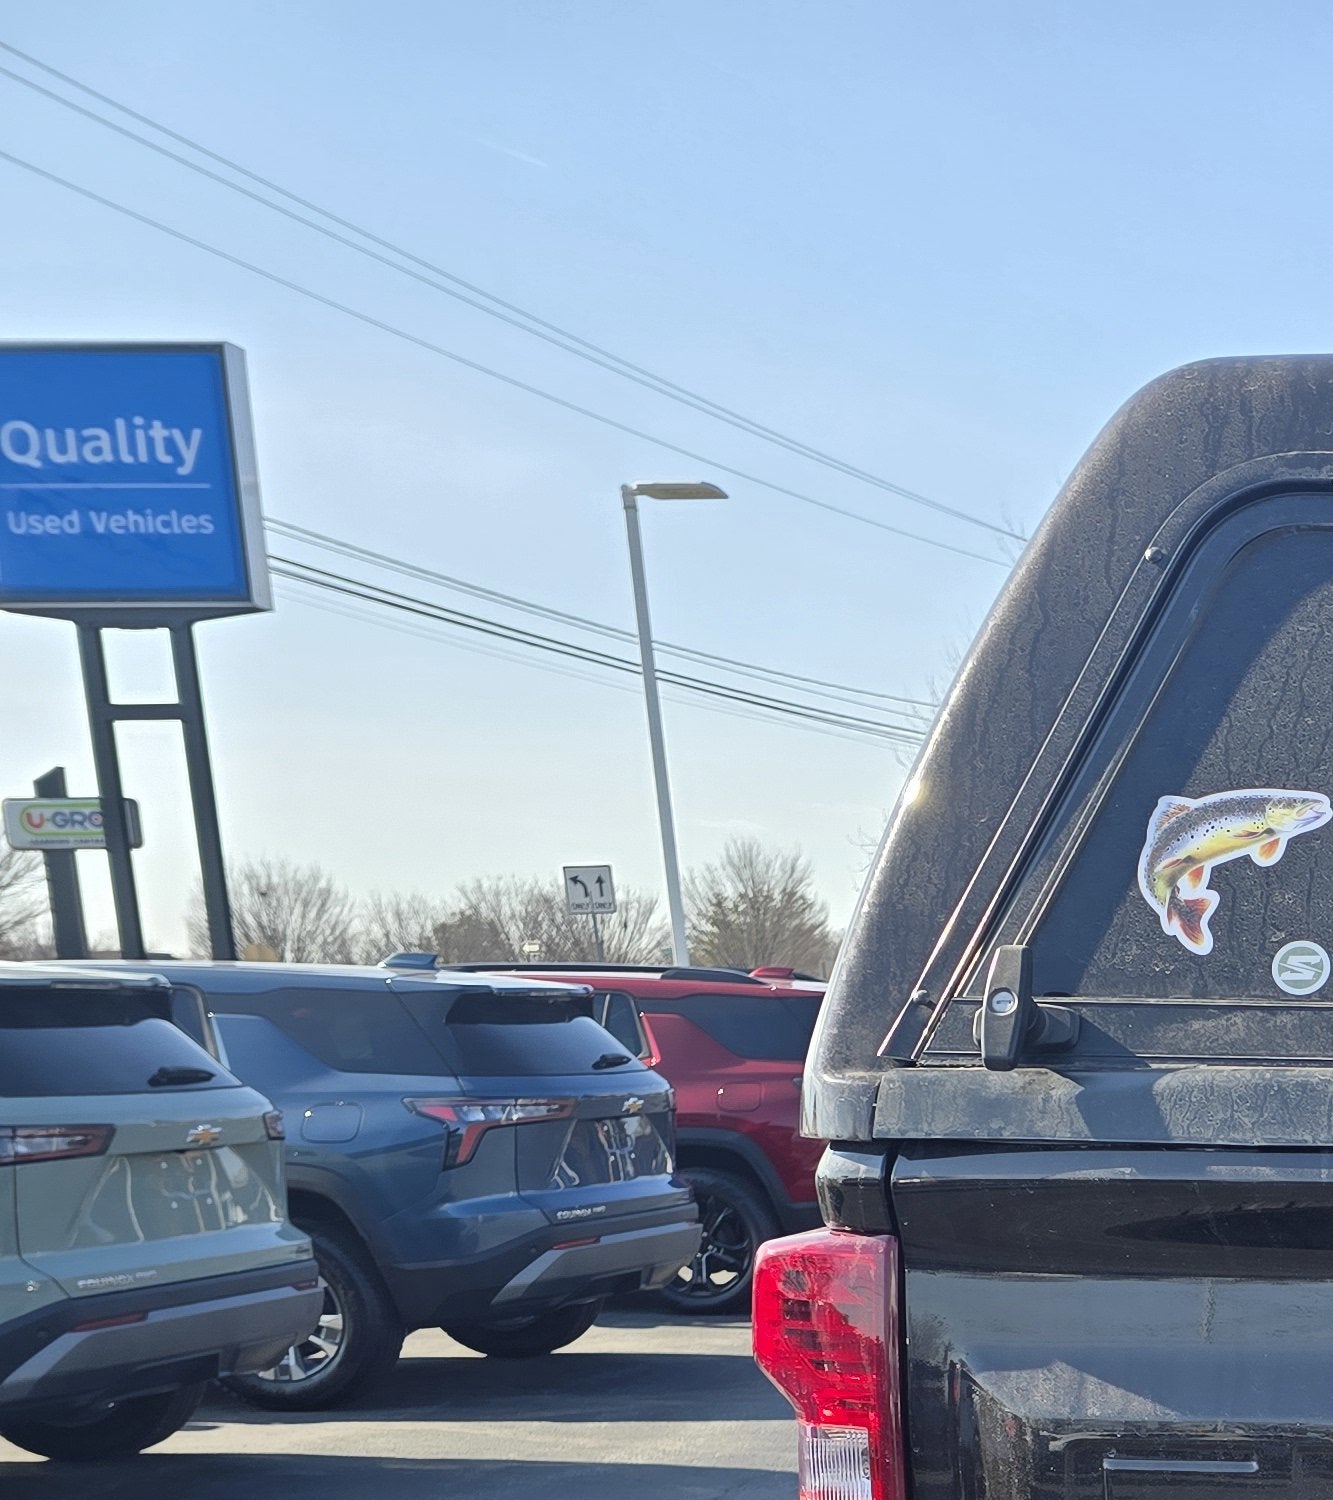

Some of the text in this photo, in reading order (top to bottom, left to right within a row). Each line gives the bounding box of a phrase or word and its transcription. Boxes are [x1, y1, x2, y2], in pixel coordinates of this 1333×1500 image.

[1, 416, 202, 476] Quality
[7, 508, 215, 535] Used Vehicles
